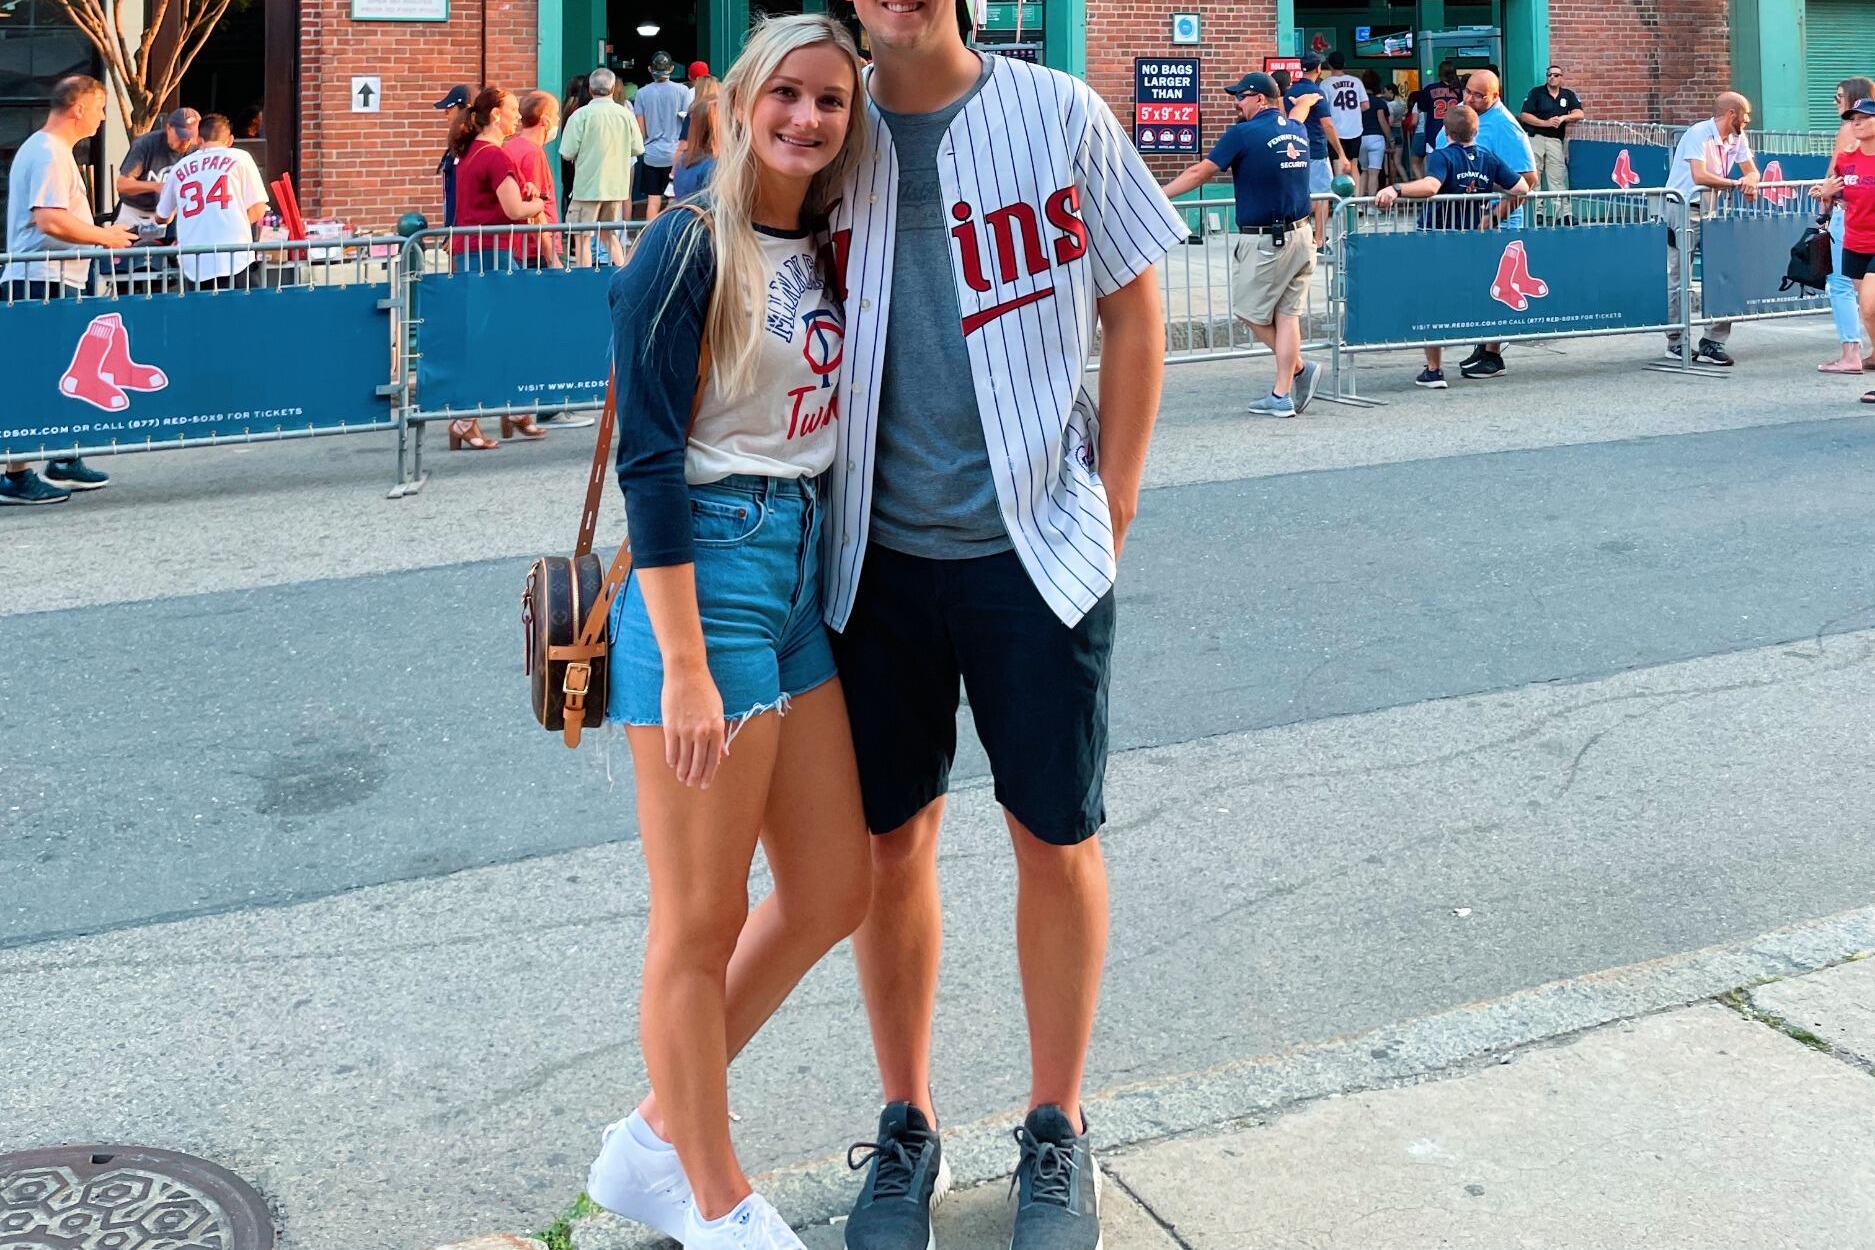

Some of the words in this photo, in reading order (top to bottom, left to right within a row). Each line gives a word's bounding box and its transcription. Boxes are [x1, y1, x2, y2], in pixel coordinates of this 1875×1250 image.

[1141, 64, 1158, 75] NO
[1161, 64, 1193, 75] BAGS
[1144, 76, 1190, 87] LARGER
[1152, 89, 1183, 99] THAN
[1333, 89, 1358, 111] 48
[1267, 134, 1292, 148] FENWAY
[175, 160, 199, 182] BIG
[201, 155, 237, 172] PAPI
[1280, 160, 1308, 169] SECURITY
[179, 174, 233, 219] 34
[518, 383, 545, 392] VISIT
[0, 425, 69, 439] DSOX.COM
[72, 424, 90, 433] OR
[94, 421, 125, 431] CALL
[227, 410, 250, 421] FOR
[254, 407, 303, 419] TICKETS
